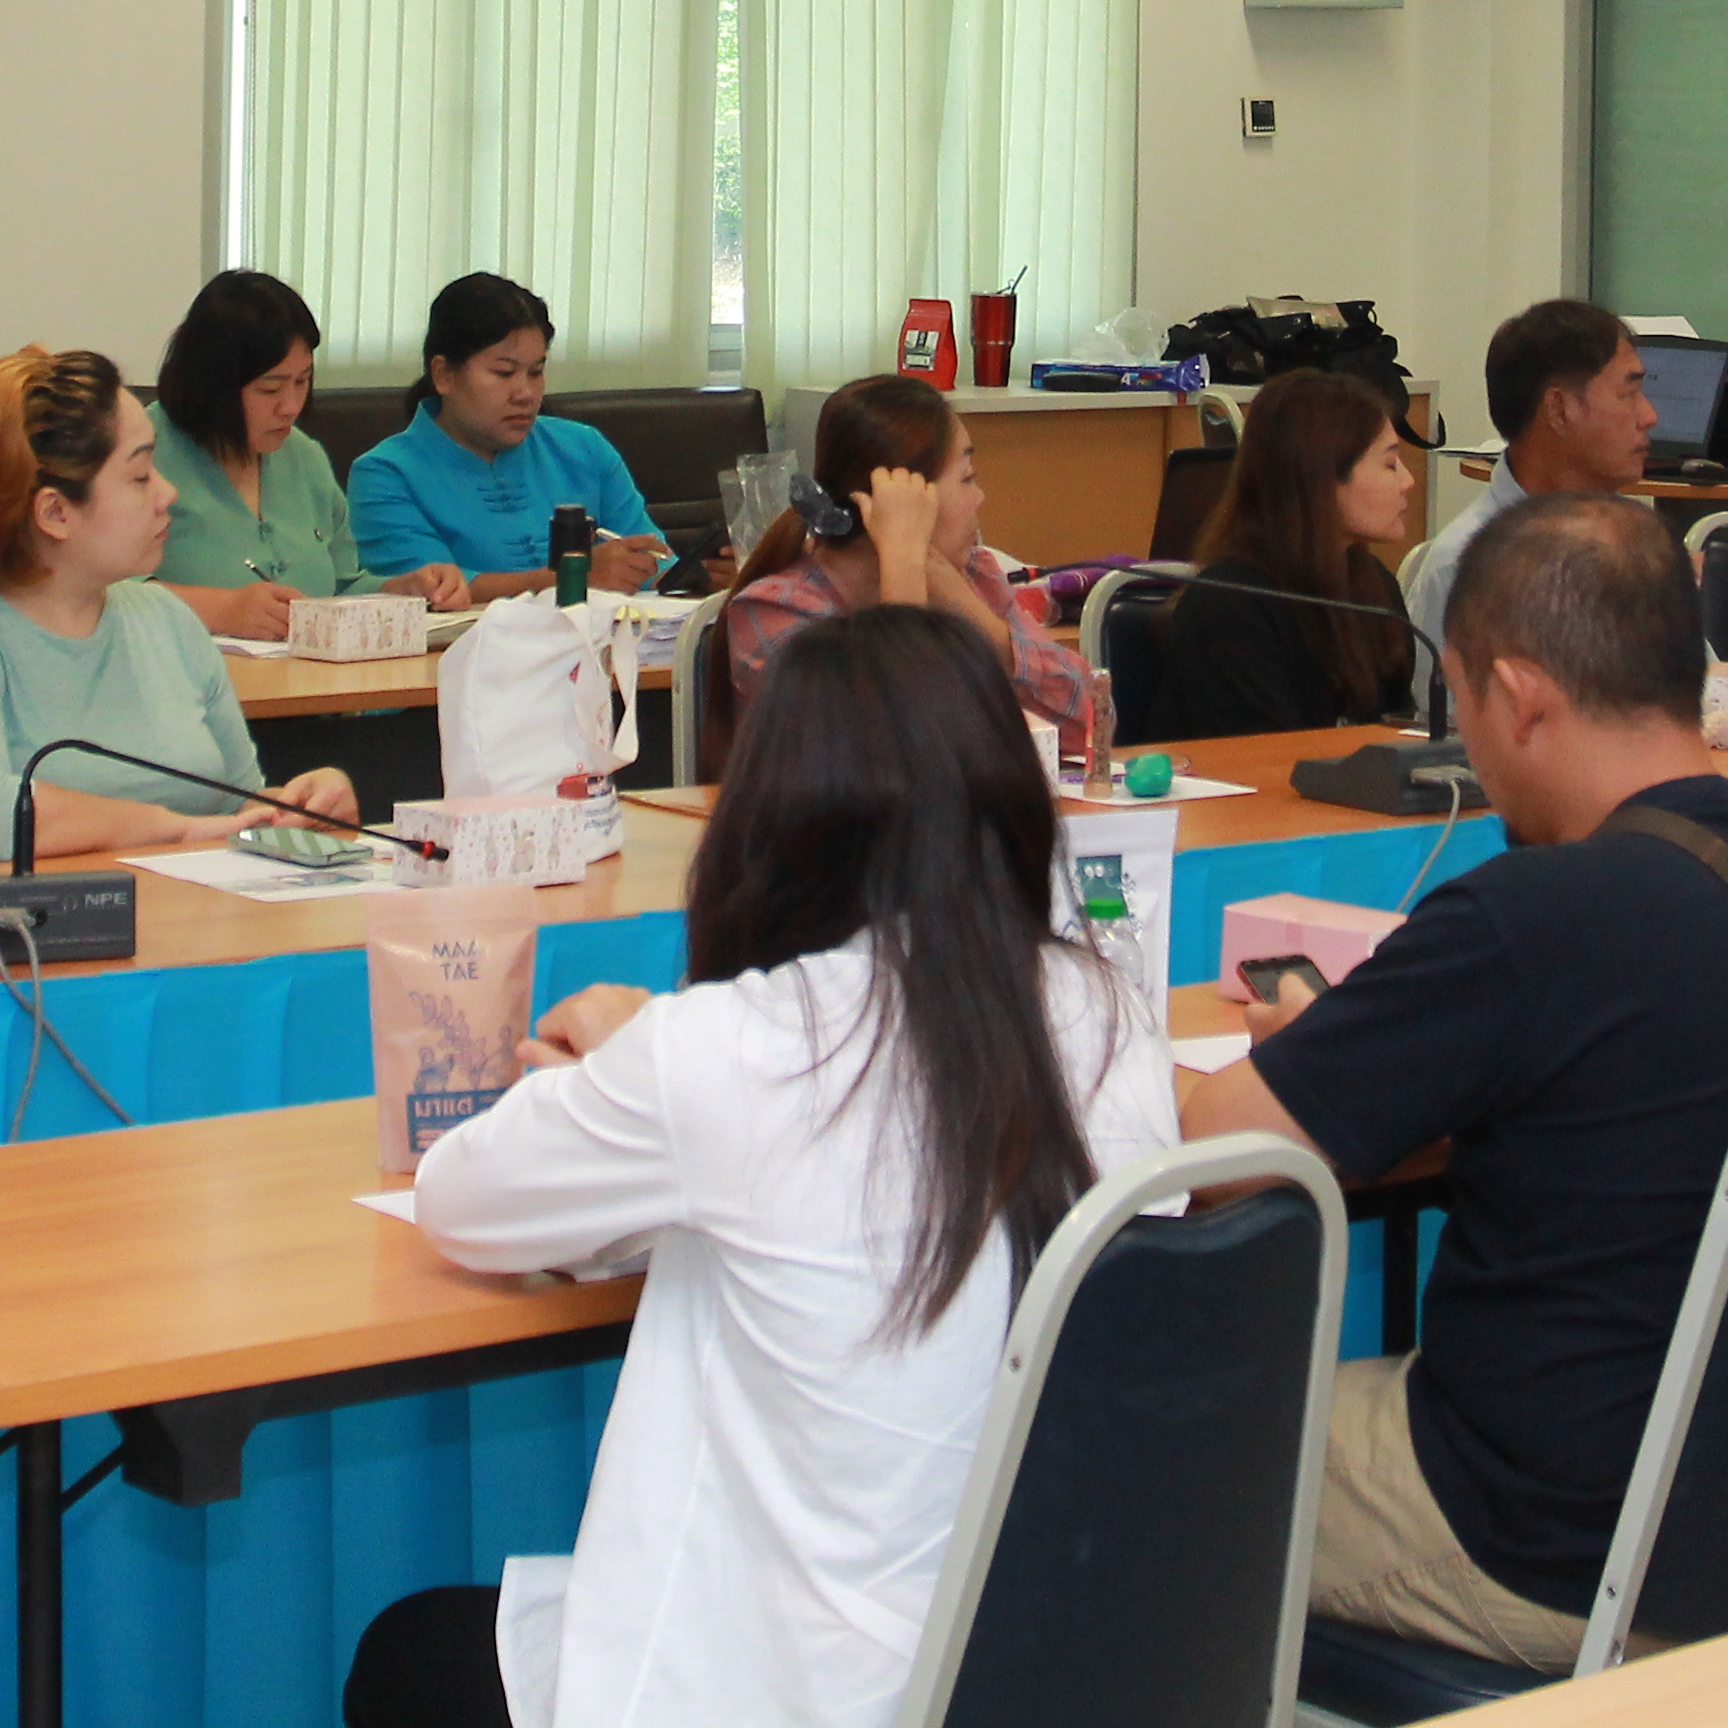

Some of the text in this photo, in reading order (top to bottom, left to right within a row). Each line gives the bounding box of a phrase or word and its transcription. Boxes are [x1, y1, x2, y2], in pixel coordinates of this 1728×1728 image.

[84, 892, 128, 906] NPE
[432, 941, 481, 958] MAA
[440, 962, 479, 981] TAE
